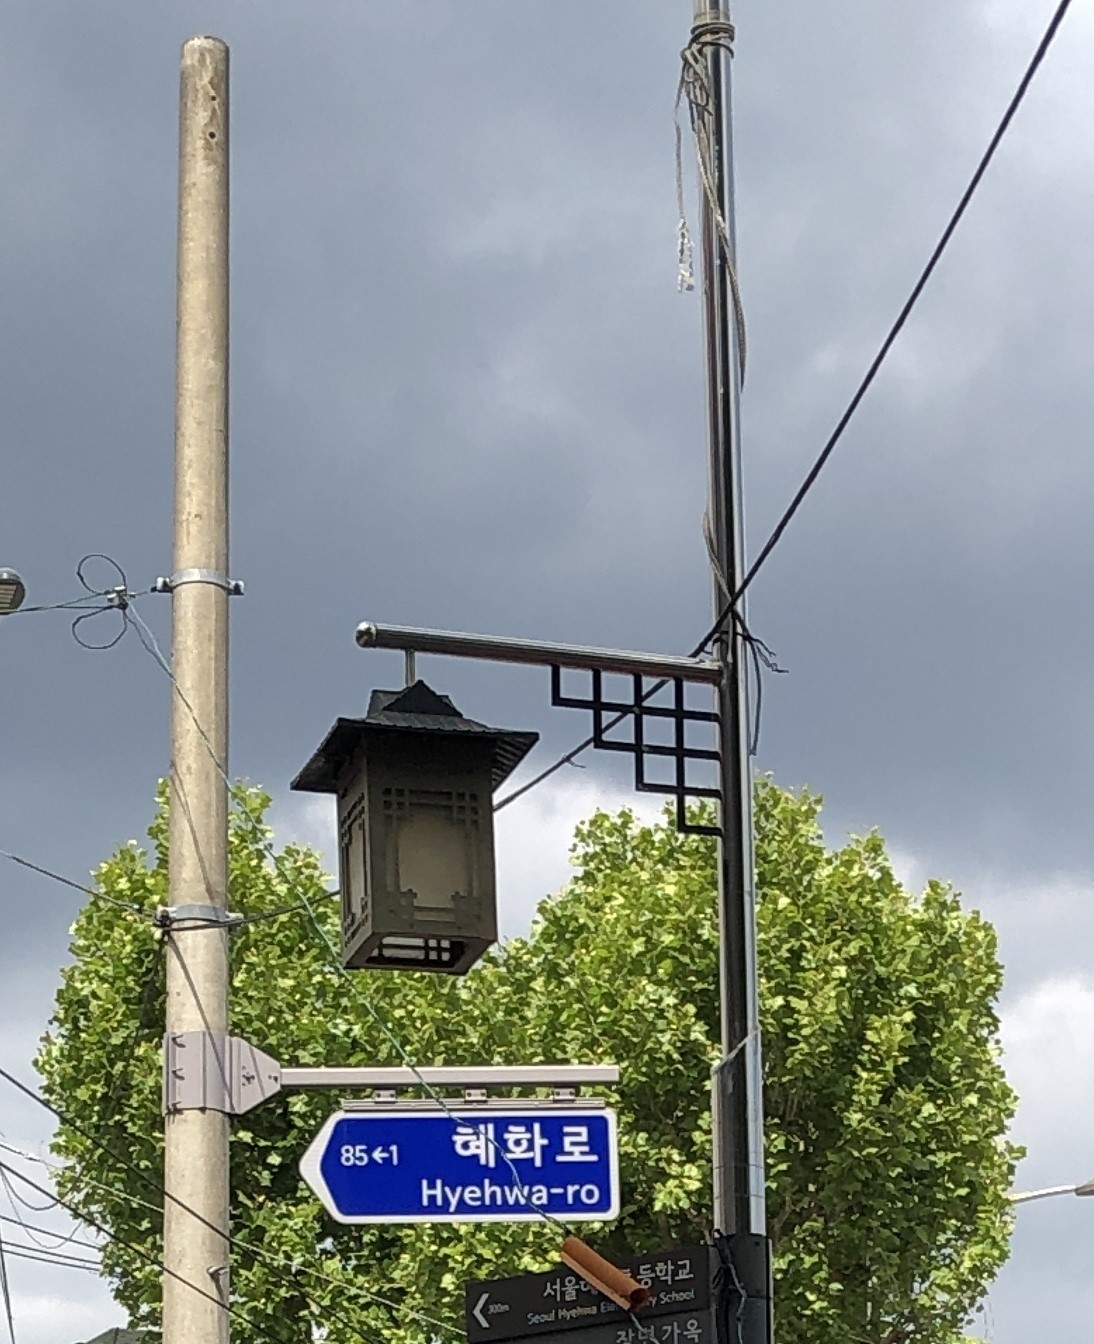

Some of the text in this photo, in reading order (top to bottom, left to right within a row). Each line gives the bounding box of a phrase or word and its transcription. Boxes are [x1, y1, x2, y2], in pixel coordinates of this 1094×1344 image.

[452, 1122, 599, 1168] 혜화로
[421, 1179, 600, 1212] Hyehwa-ro
[543, 1259, 694, 1302] 서울등학교
[527, 1311, 555, 1325] Seoul
[660, 1288, 694, 1304] School
[662, 1319, 702, 1344] 가옥
